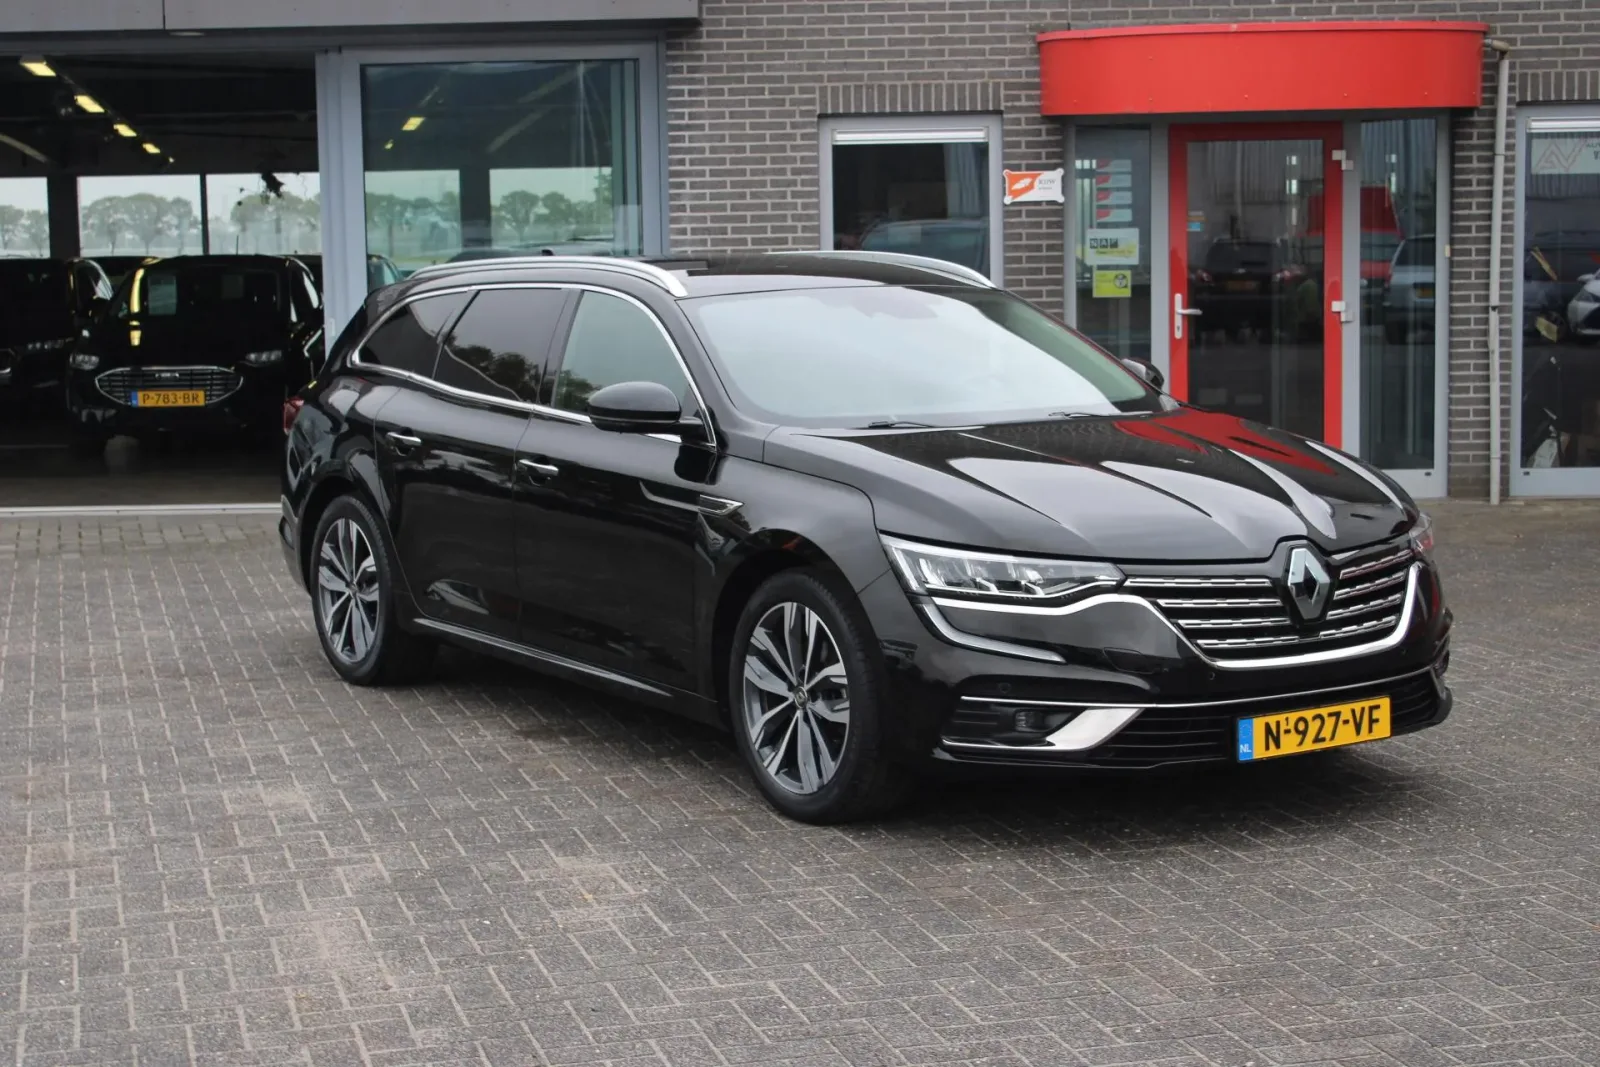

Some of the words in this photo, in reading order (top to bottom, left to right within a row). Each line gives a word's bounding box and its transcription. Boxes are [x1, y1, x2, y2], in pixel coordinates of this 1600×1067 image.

[142, 393, 200, 404] P-783-BR
[1264, 704, 1381, 751] N-927-VF
[1239, 744, 1252, 753] NL
